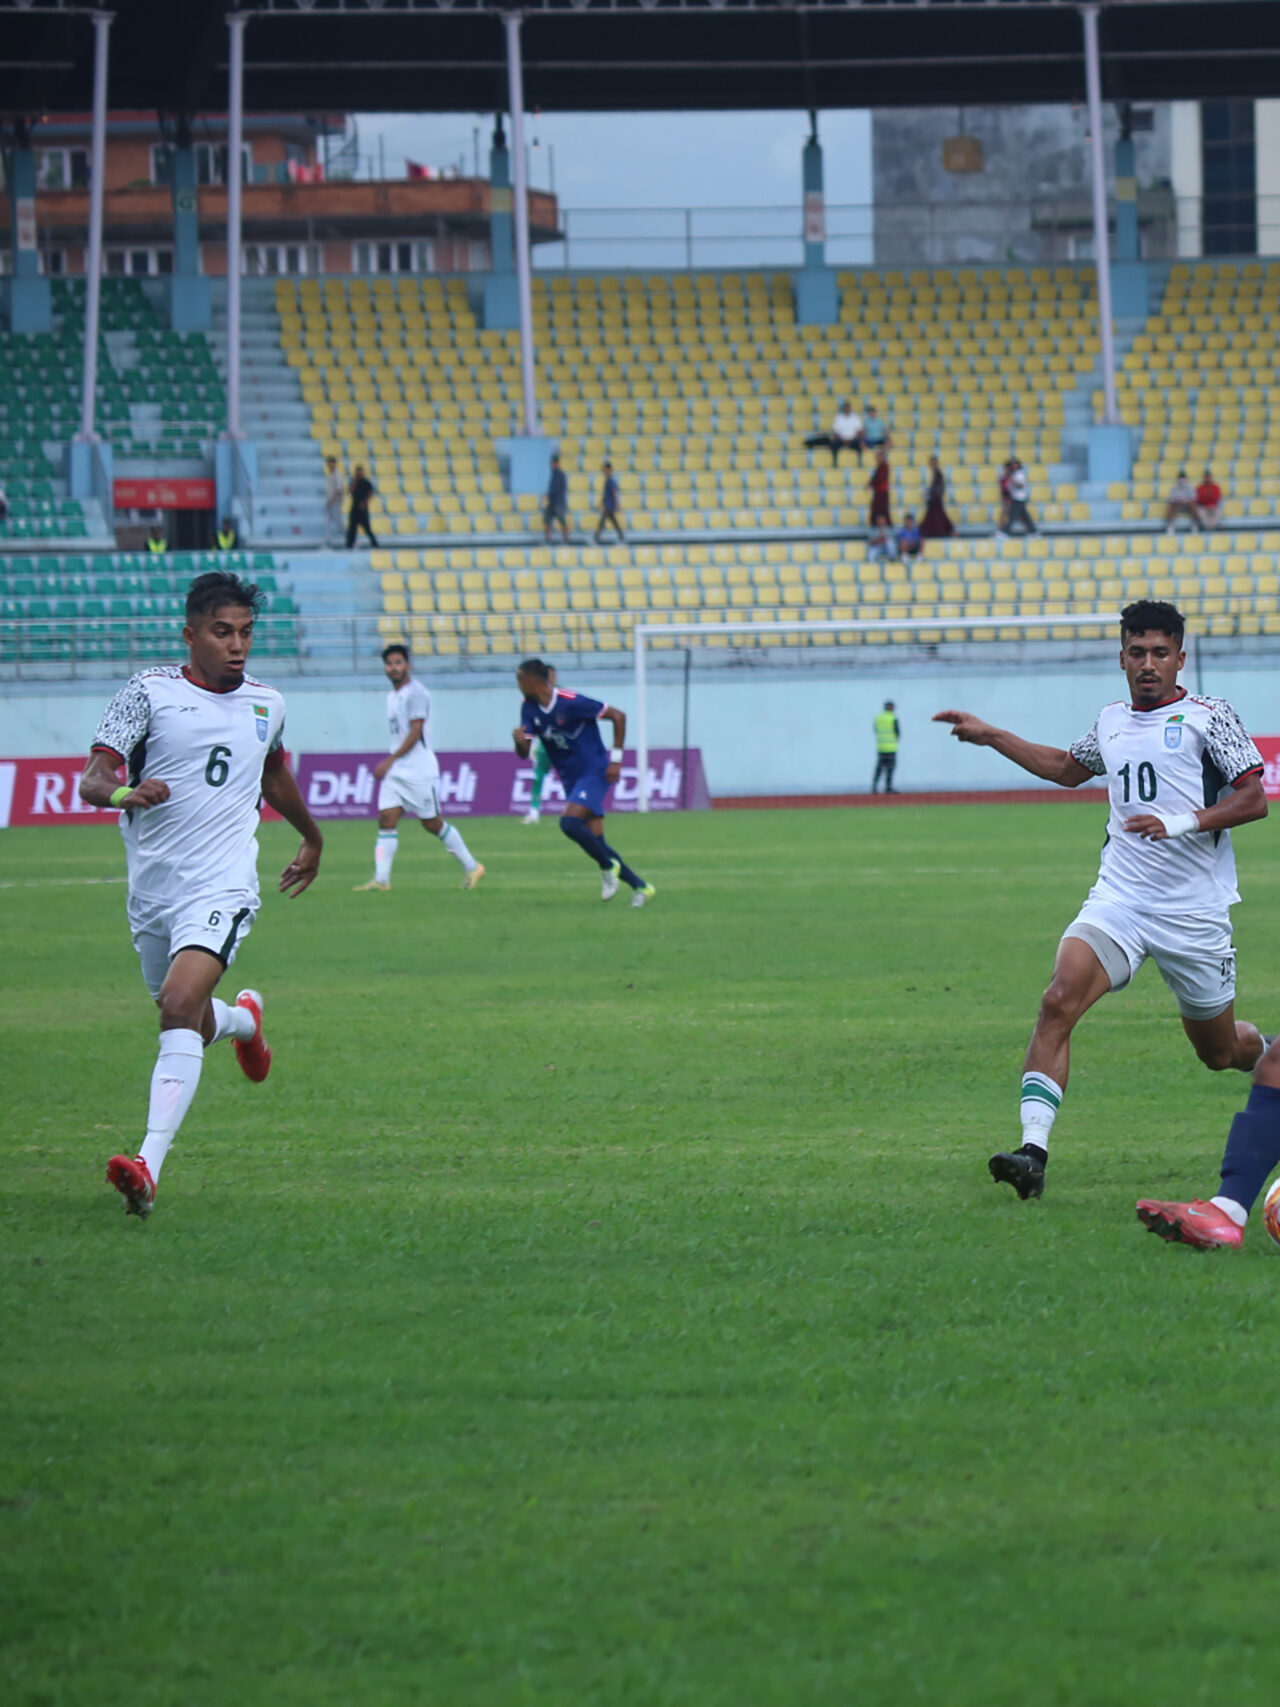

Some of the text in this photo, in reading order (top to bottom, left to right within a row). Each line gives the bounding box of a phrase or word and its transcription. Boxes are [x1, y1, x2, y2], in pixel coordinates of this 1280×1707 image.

[205, 745, 233, 788] 6
[1117, 761, 1158, 803] 10
[208, 910, 222, 927] 6
